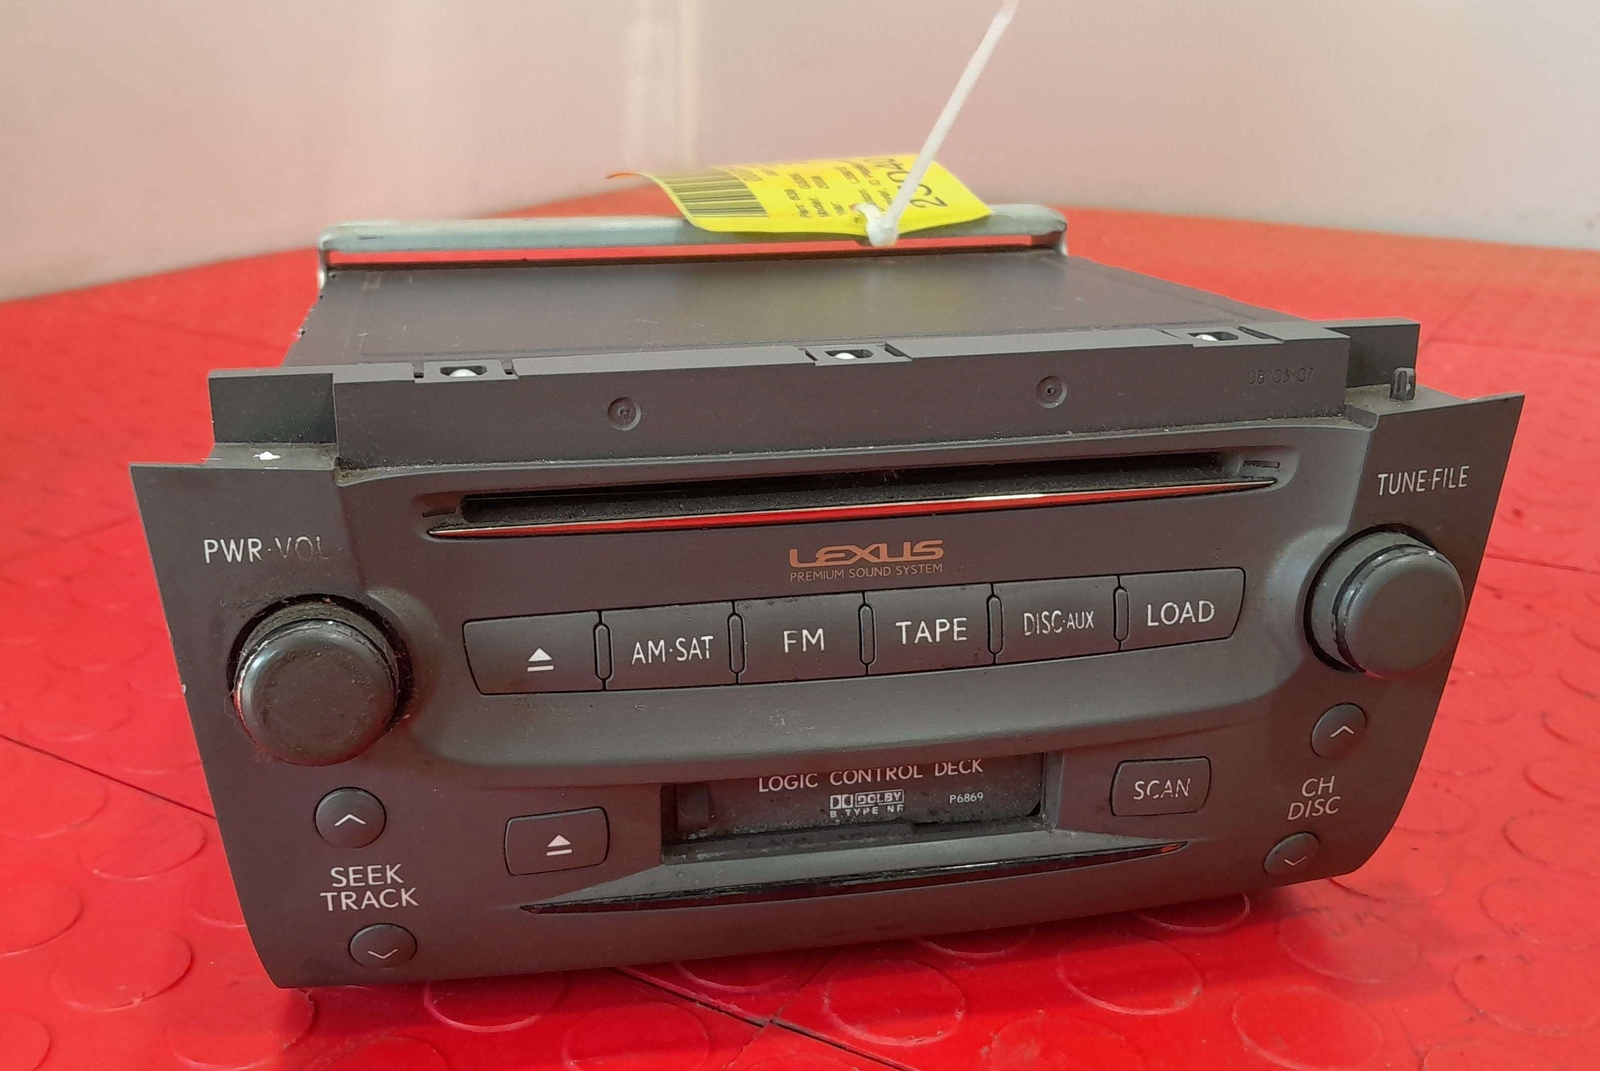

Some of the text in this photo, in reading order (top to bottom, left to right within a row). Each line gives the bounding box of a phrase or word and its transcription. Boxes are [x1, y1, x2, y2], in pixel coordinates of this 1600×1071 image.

[789, 540, 944, 567] LEXUS
[790, 563, 943, 583] PREMIUM SOUND SYSTEM
[1146, 600, 1215, 627] LOAD
[783, 628, 825, 653] FM
[895, 617, 968, 645] TAPE
[758, 759, 984, 793] LOGIC CONTROL DECK
[1301, 775, 1335, 798] CH
[857, 791, 902, 804] DOLBY
[949, 791, 984, 805] P6869
[1133, 777, 1191, 800] SCAN
[830, 810, 837, 818] B
[845, 806, 879, 817] TYPE
[1287, 796, 1341, 821] DISC
[330, 863, 404, 888] SEEK
[319, 887, 420, 911] TRACK
